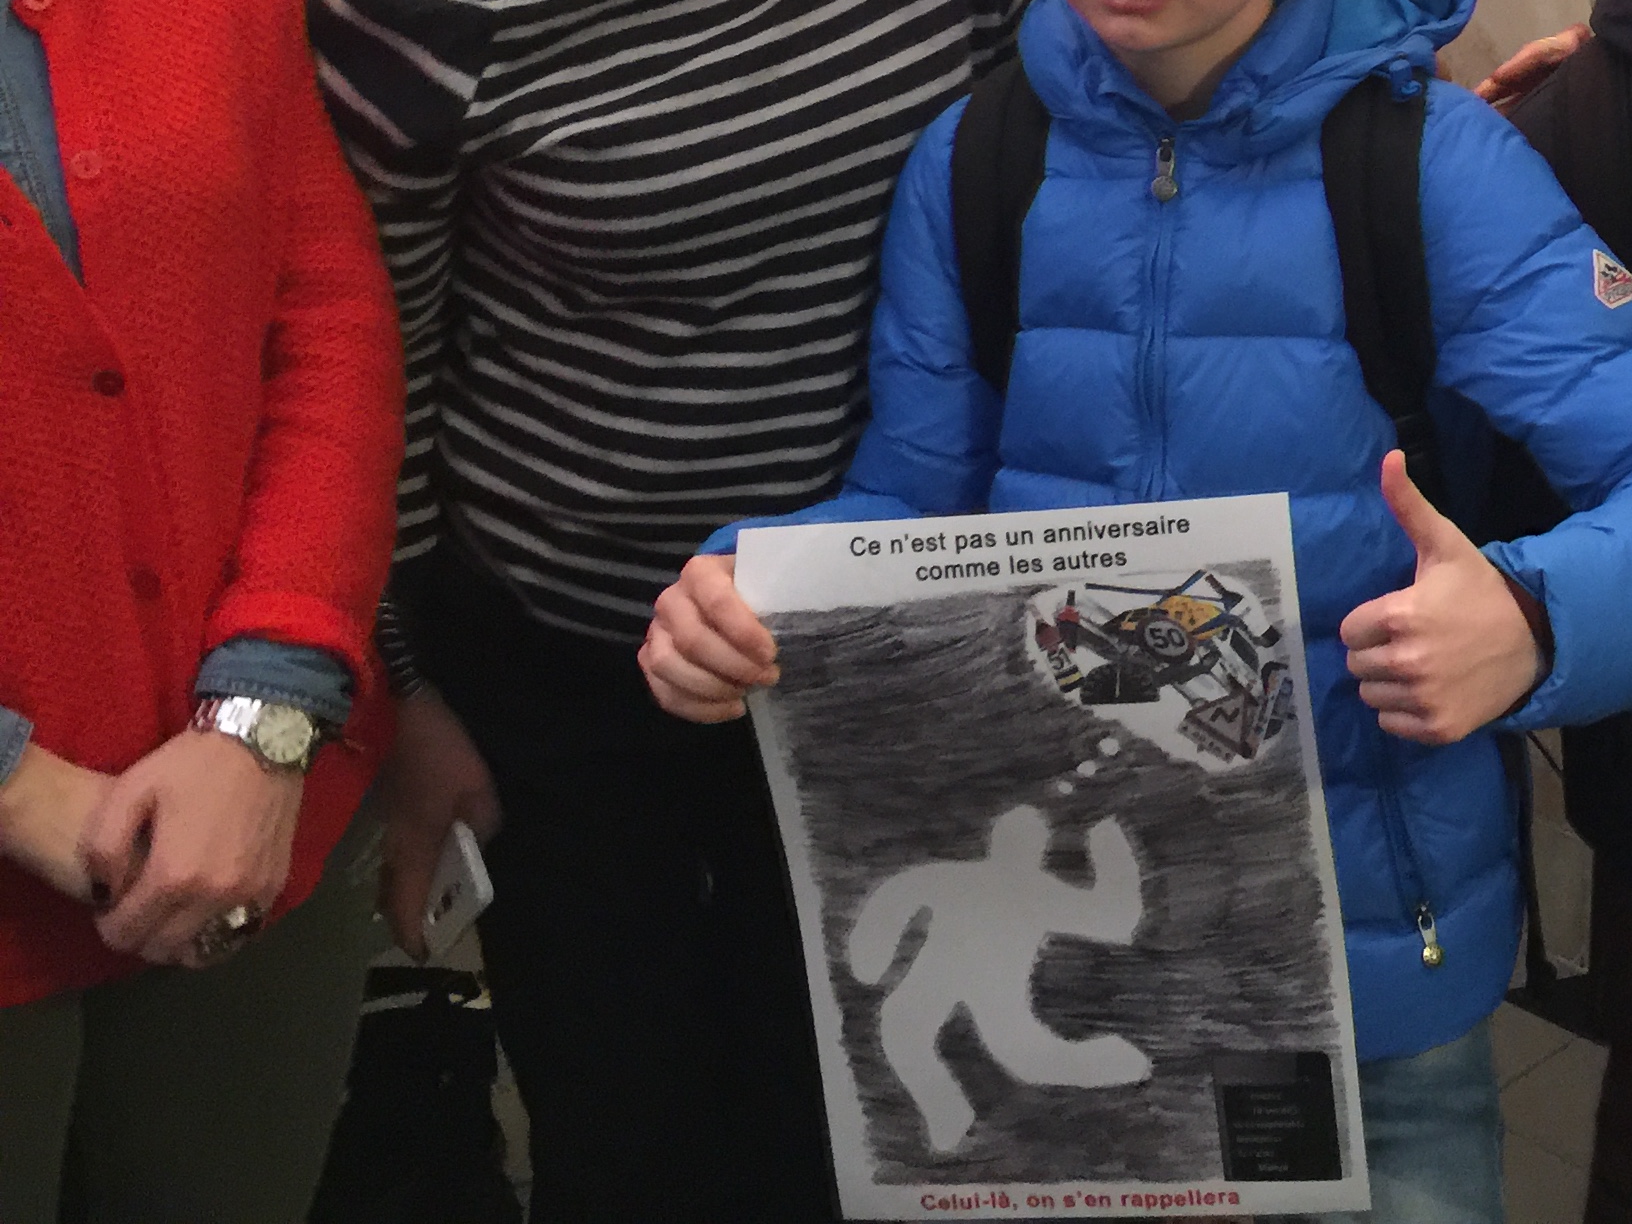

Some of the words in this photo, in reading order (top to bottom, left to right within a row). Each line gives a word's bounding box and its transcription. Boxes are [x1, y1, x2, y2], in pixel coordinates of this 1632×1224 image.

[849, 536, 882, 557] Ce
[890, 532, 947, 556] n'est
[955, 531, 997, 554] pas
[1005, 530, 1034, 547] un
[1043, 515, 1191, 545] anniversaire
[915, 560, 1000, 582] comme
[1009, 554, 1044, 575] les
[1052, 548, 1128, 572] autres
[1150, 627, 1186, 649] 50
[921, 1190, 1018, 1212] Celui-là,
[1026, 1193, 1055, 1209] on
[1062, 1190, 1112, 1208] s'en
[1120, 1188, 1241, 1210] rappellera
